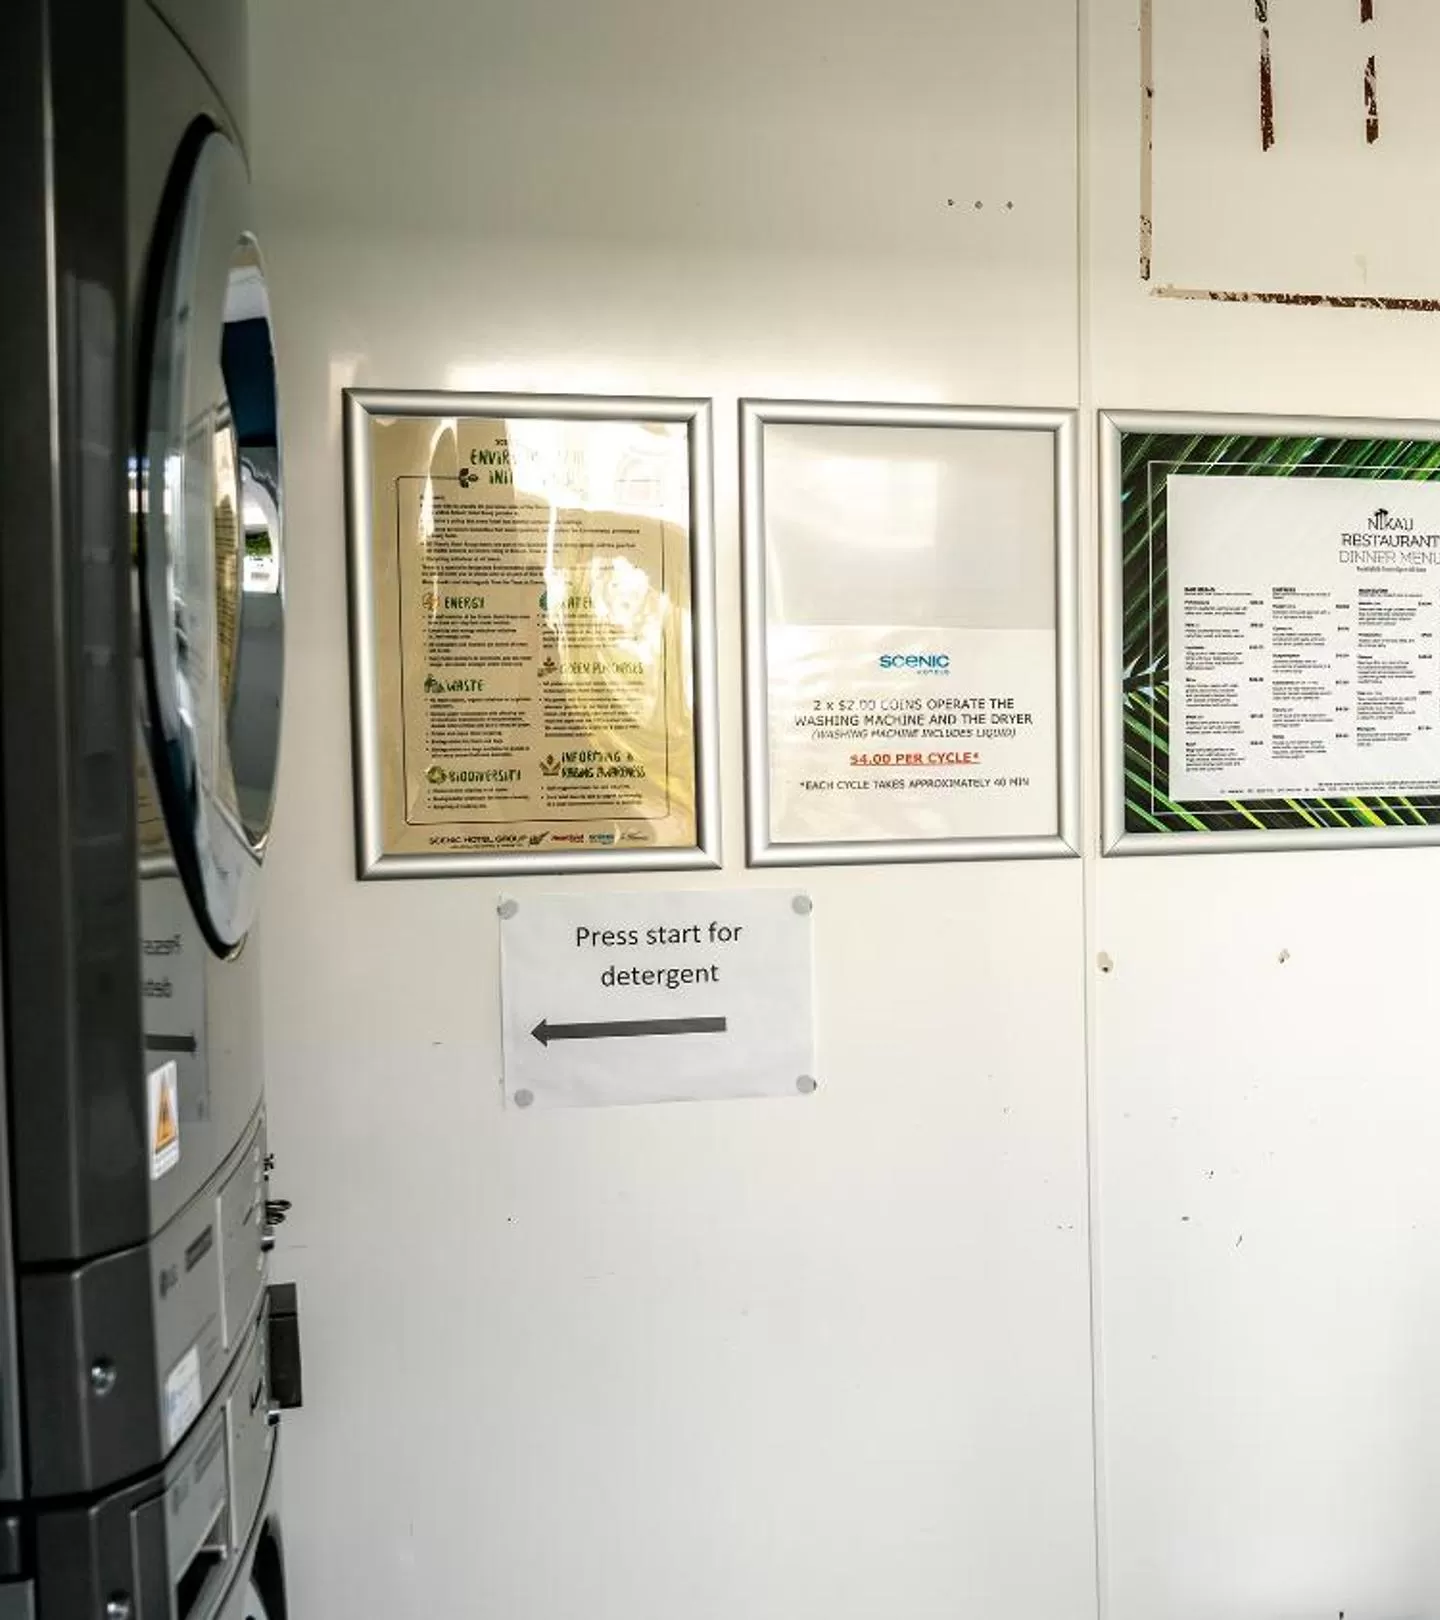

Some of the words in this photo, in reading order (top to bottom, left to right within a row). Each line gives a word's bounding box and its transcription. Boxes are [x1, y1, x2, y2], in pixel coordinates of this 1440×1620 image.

[1367, 509, 1414, 531] NIKAU
[1341, 533, 1440, 548] RESTAURANT
[1339, 550, 1396, 564] DINNER
[444, 596, 485, 609] ENERGY
[446, 678, 485, 692] WASTE
[813, 700, 821, 711] 2
[880, 699, 922, 711] COINS
[926, 699, 985, 710] OPERATE
[991, 698, 1015, 709] THE
[795, 715, 860, 727] WASHING
[863, 714, 925, 726] MACHINE
[928, 714, 957, 725] AND
[962, 714, 987, 725] THE
[991, 713, 1033, 725] DRYER
[811, 729, 868, 740] (WASHING
[871, 728, 918, 740] MACHINE
[921, 728, 973, 739] INCLUDES
[850, 753, 892, 766] $4.00
[895, 753, 923, 765] PER
[836, 779, 870, 790] CYCLE
[873, 779, 907, 790] TAKES
[909, 777, 990, 789] APPROXIMATELY
[993, 778, 1007, 787] 40
[1009, 776, 1030, 787] MIN
[464, 836, 492, 844] HOTEL
[576, 926, 638, 947] Press
[646, 924, 701, 945] start
[708, 921, 743, 943] for
[600, 963, 720, 989] detergent
